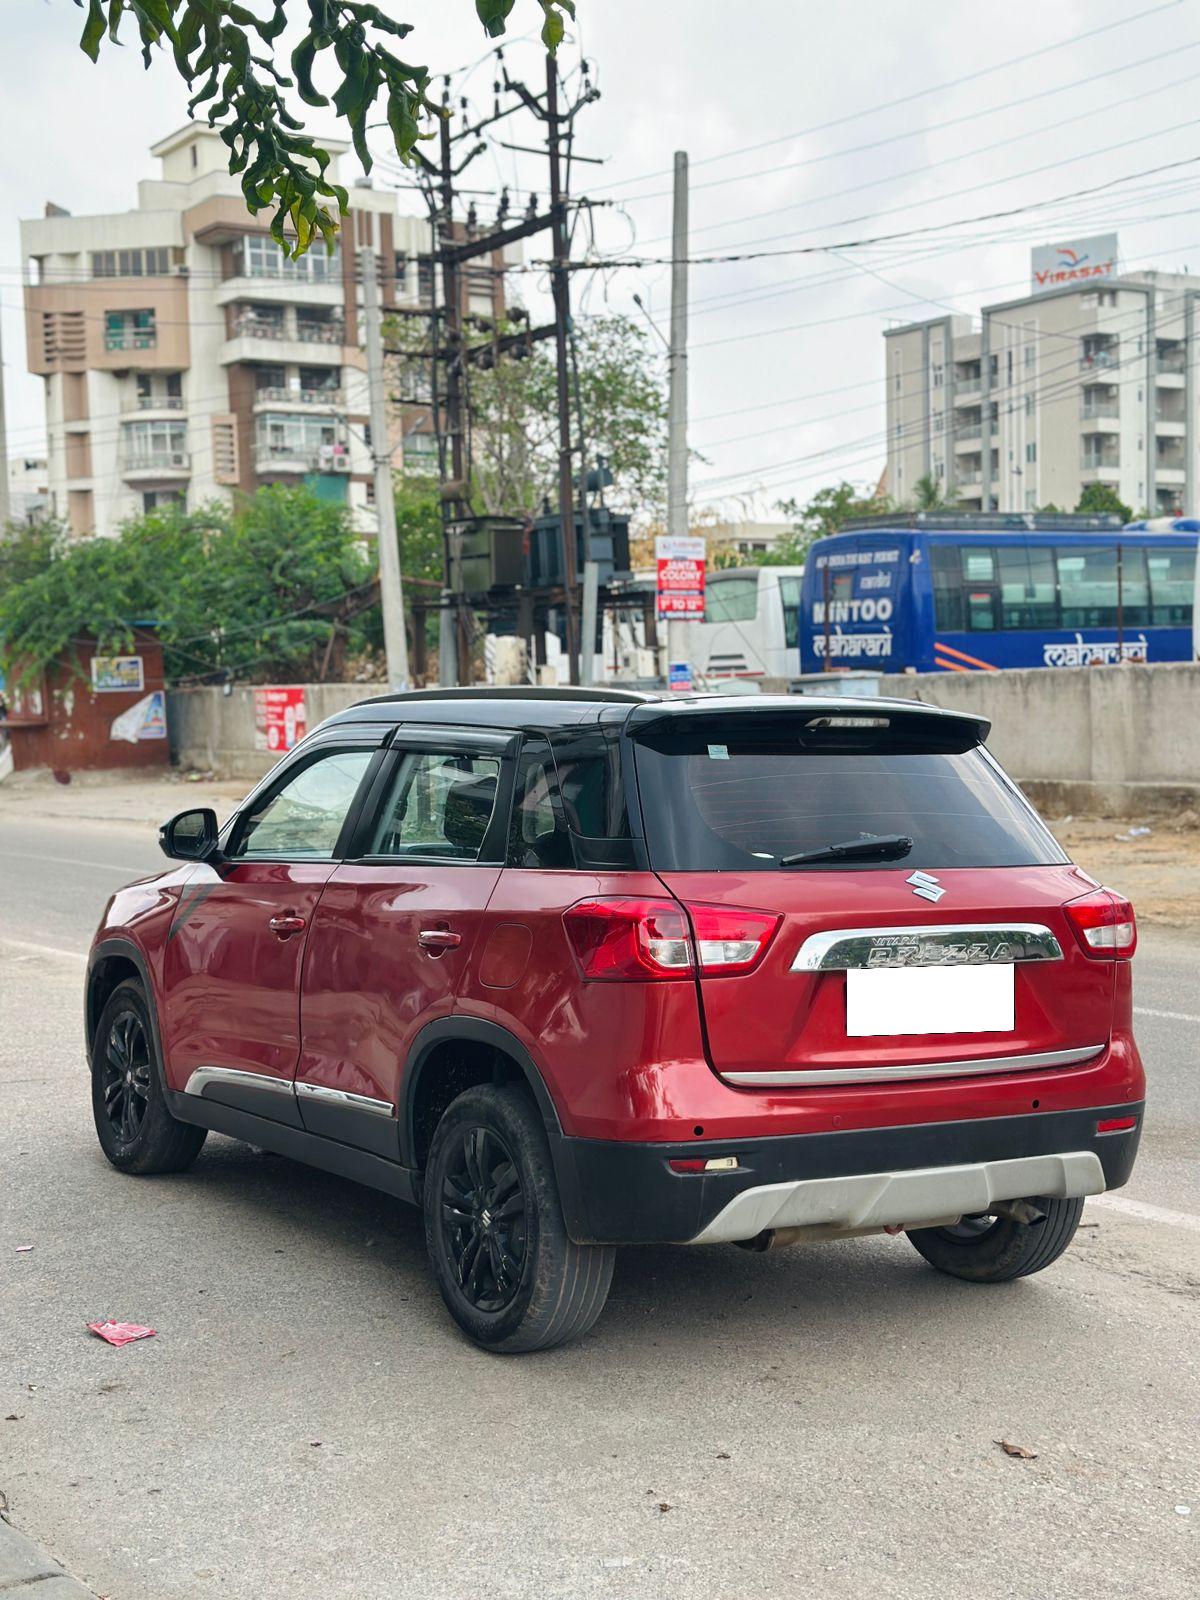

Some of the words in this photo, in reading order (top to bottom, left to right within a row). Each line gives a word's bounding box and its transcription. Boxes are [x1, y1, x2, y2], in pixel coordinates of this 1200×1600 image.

[1034, 262, 1113, 285] VIRASAT
[659, 570, 703, 581] COLONY
[666, 560, 698, 571] JANTA
[813, 597, 893, 624] MINTOO
[1043, 632, 1148, 667] maharani
[871, 936, 920, 946] VITARA
[867, 942, 1014, 967] BREZZA
